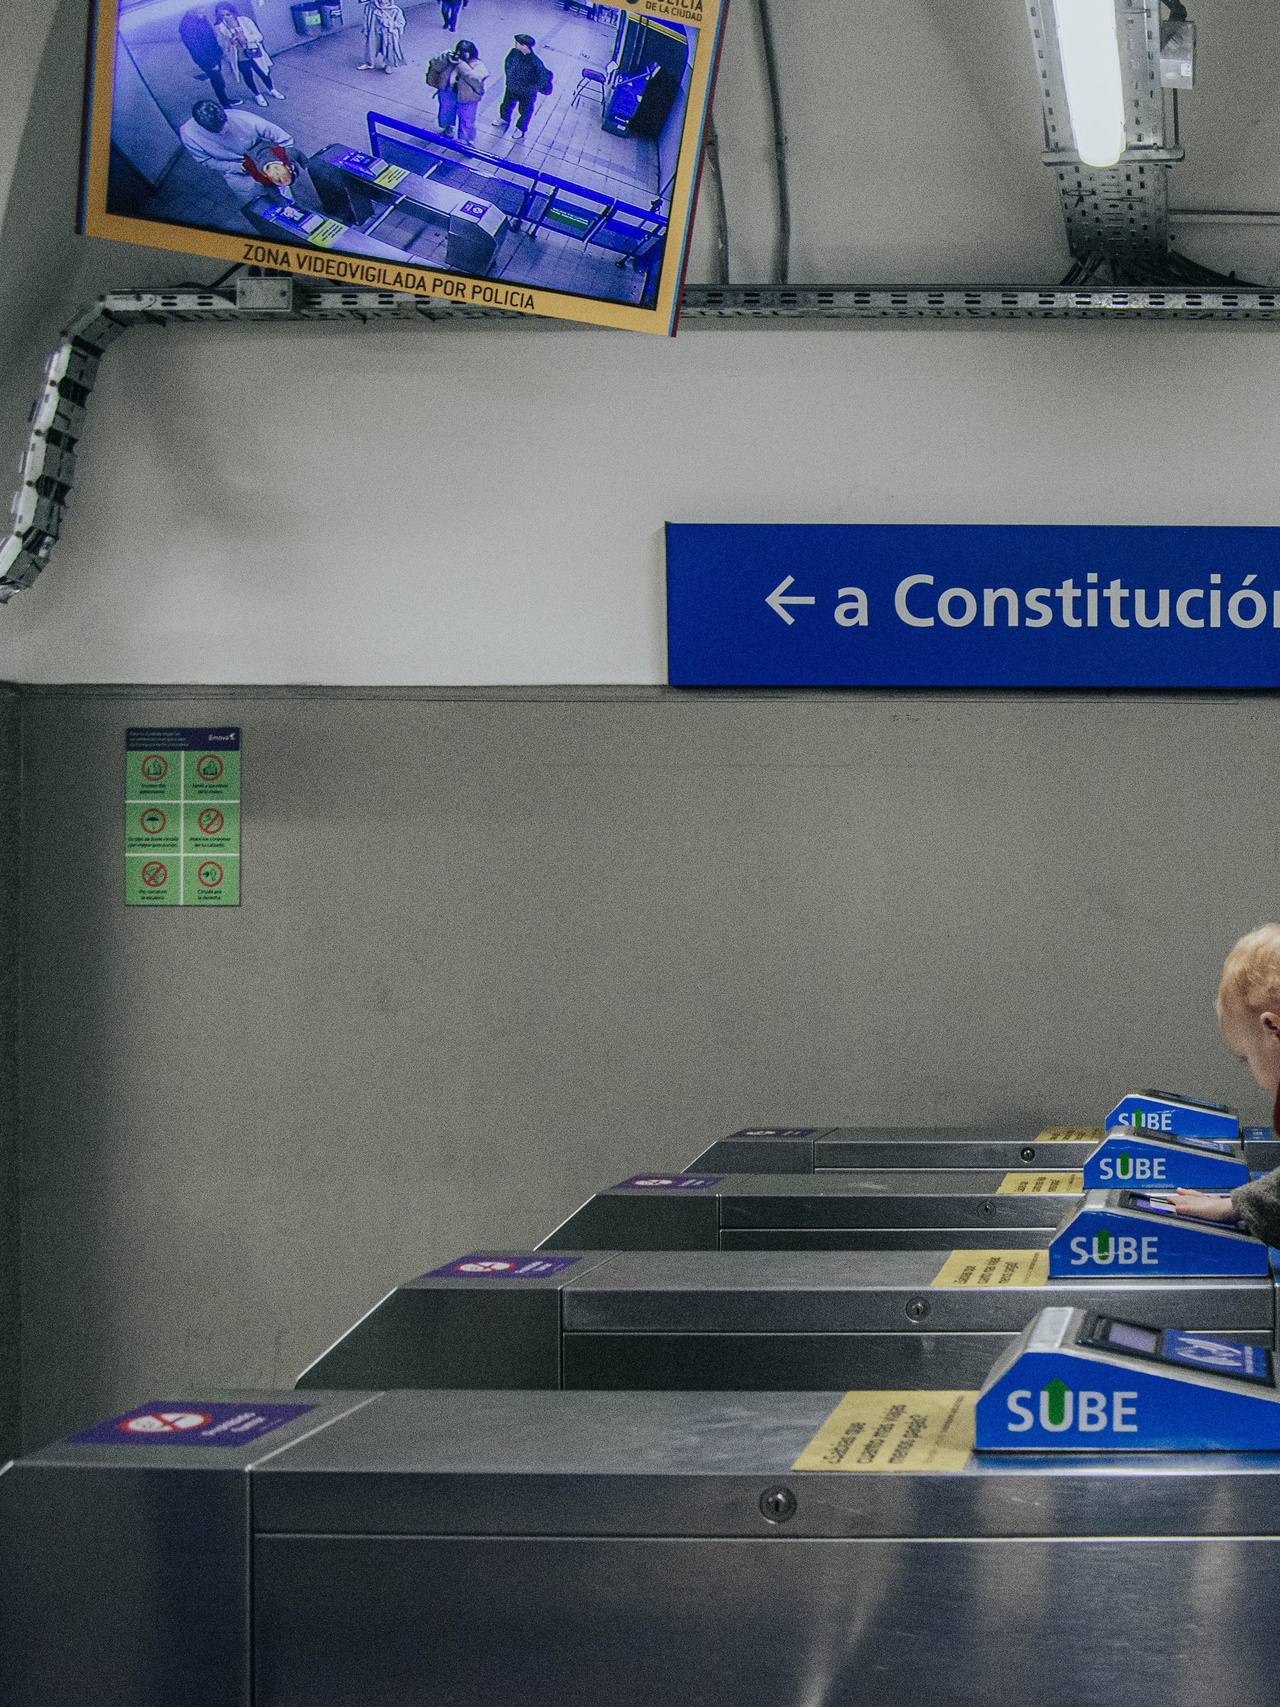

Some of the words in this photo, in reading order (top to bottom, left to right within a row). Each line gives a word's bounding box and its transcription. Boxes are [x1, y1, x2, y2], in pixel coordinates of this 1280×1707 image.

[646, 1, 657, 11] DE
[659, 5, 669, 15] LA
[671, 7, 702, 22] CIUDAD
[243, 244, 291, 269] ZONA
[296, 255, 427, 292] VIDEOVIGILADA
[432, 279, 466, 298] POR
[471, 284, 535, 310] POLICIA
[834, 586, 869, 628] a
[1118, 1112, 1172, 1131] SUBE
[1100, 1158, 1167, 1180] SUBE
[1070, 1236, 1159, 1265] SUBE
[1007, 1390, 1138, 1432] SUBE
